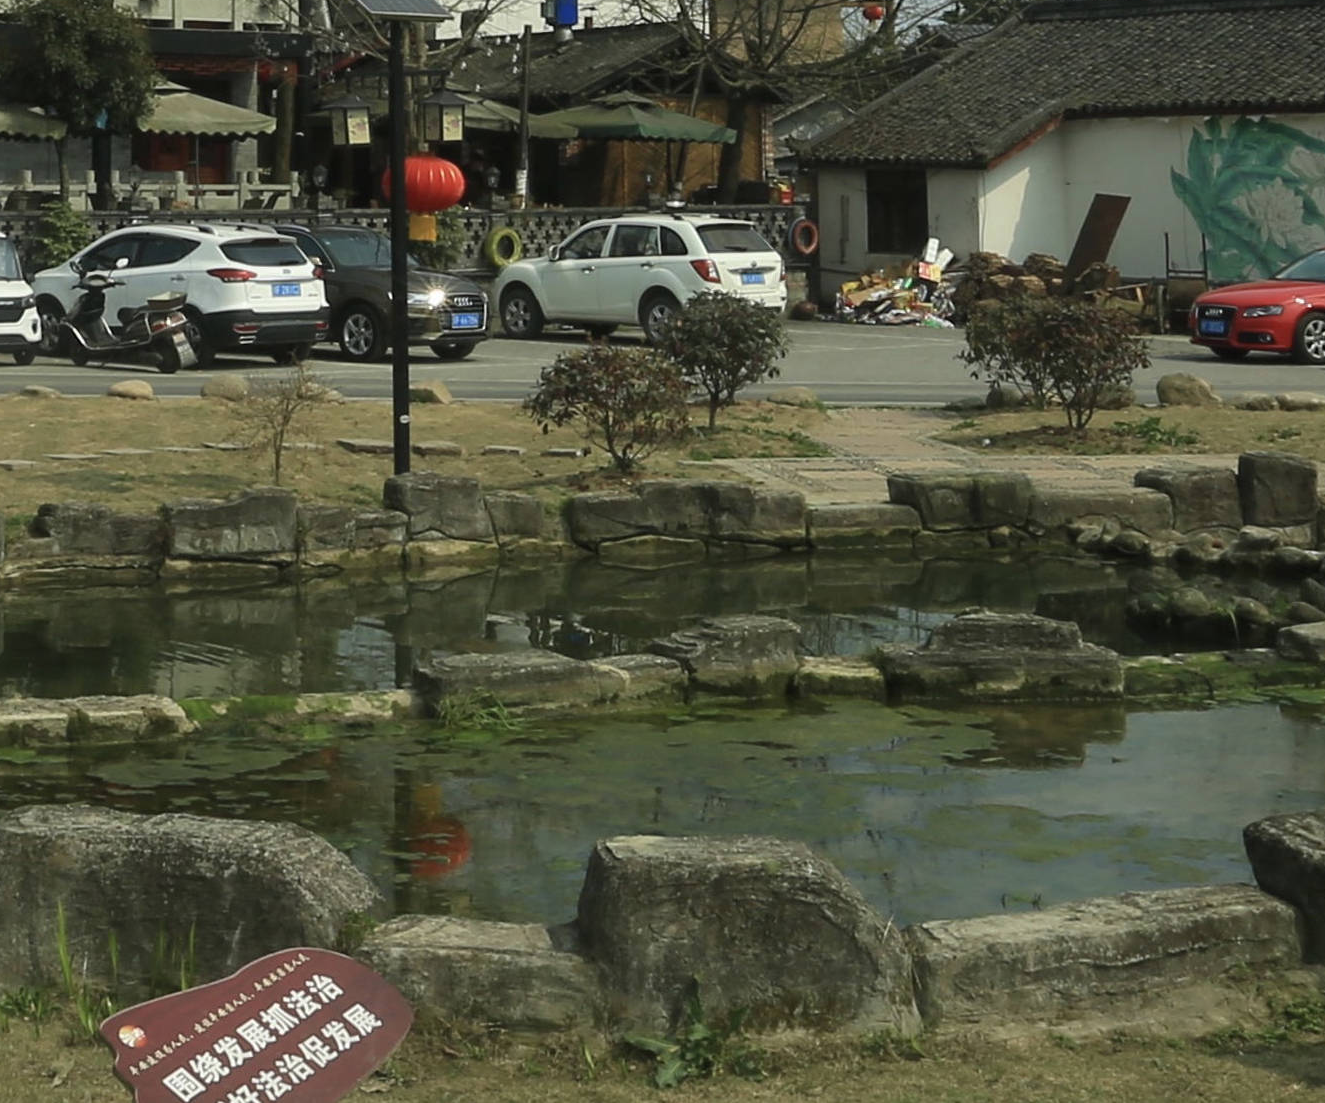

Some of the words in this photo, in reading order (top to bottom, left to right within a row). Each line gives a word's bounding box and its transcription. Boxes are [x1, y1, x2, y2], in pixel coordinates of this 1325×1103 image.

[162, 974, 344, 1103] 围绕发展抓法治
[218, 1003, 382, 1103] 好法治促发展
